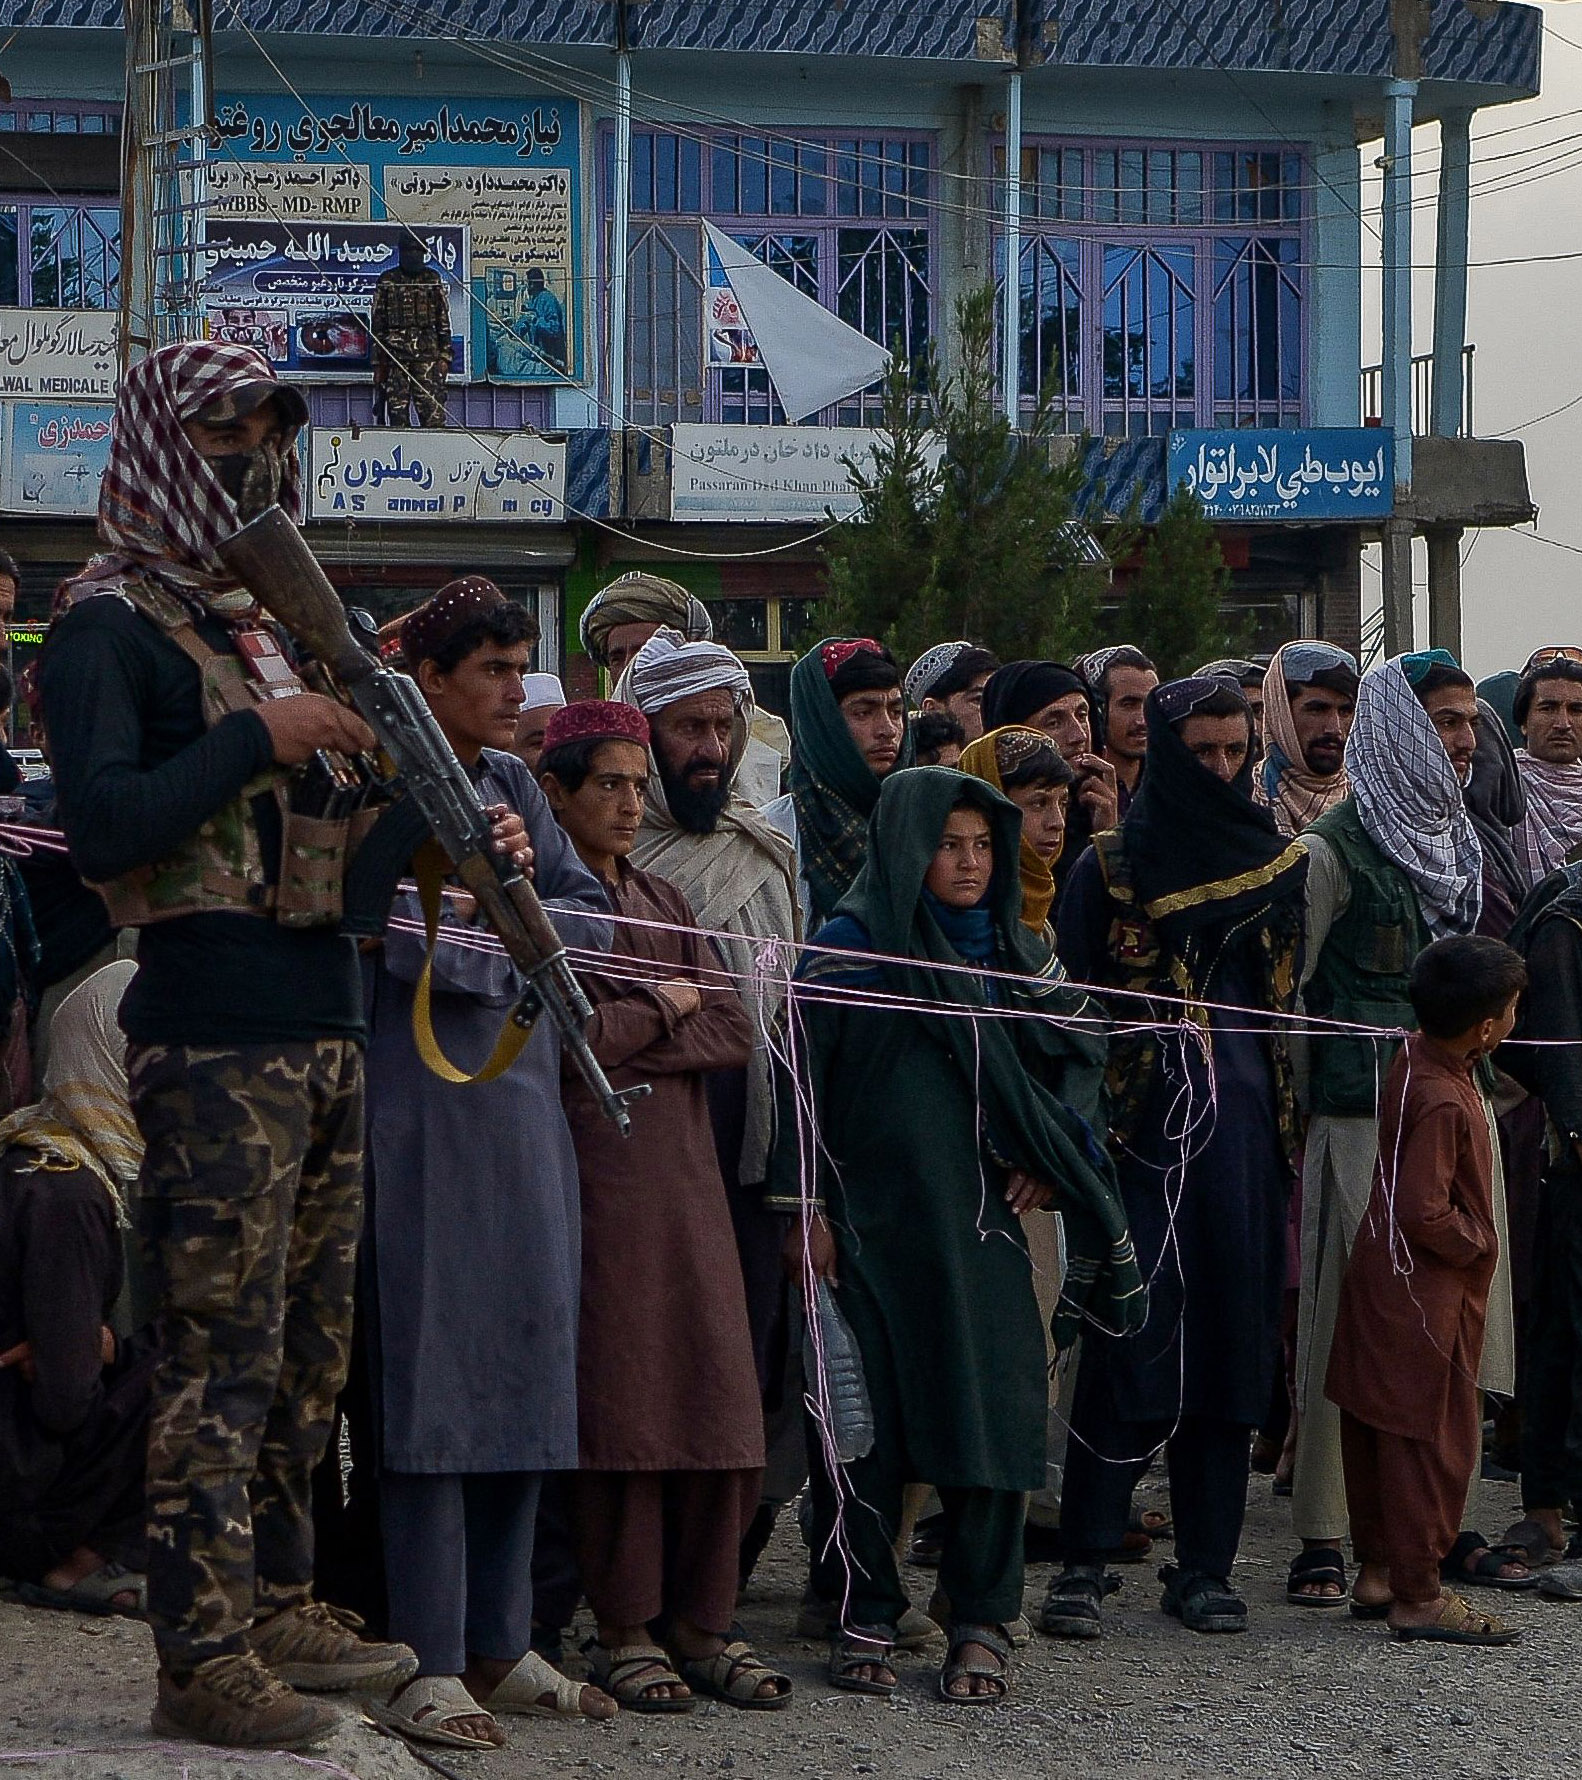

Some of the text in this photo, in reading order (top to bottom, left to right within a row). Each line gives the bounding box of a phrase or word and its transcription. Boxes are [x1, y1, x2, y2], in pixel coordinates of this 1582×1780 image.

[323, 197, 362, 214] RMP
[0, 376, 33, 392] WAL
[39, 377, 109, 394] MEDICALE
[782, 478, 818, 493] Khan
